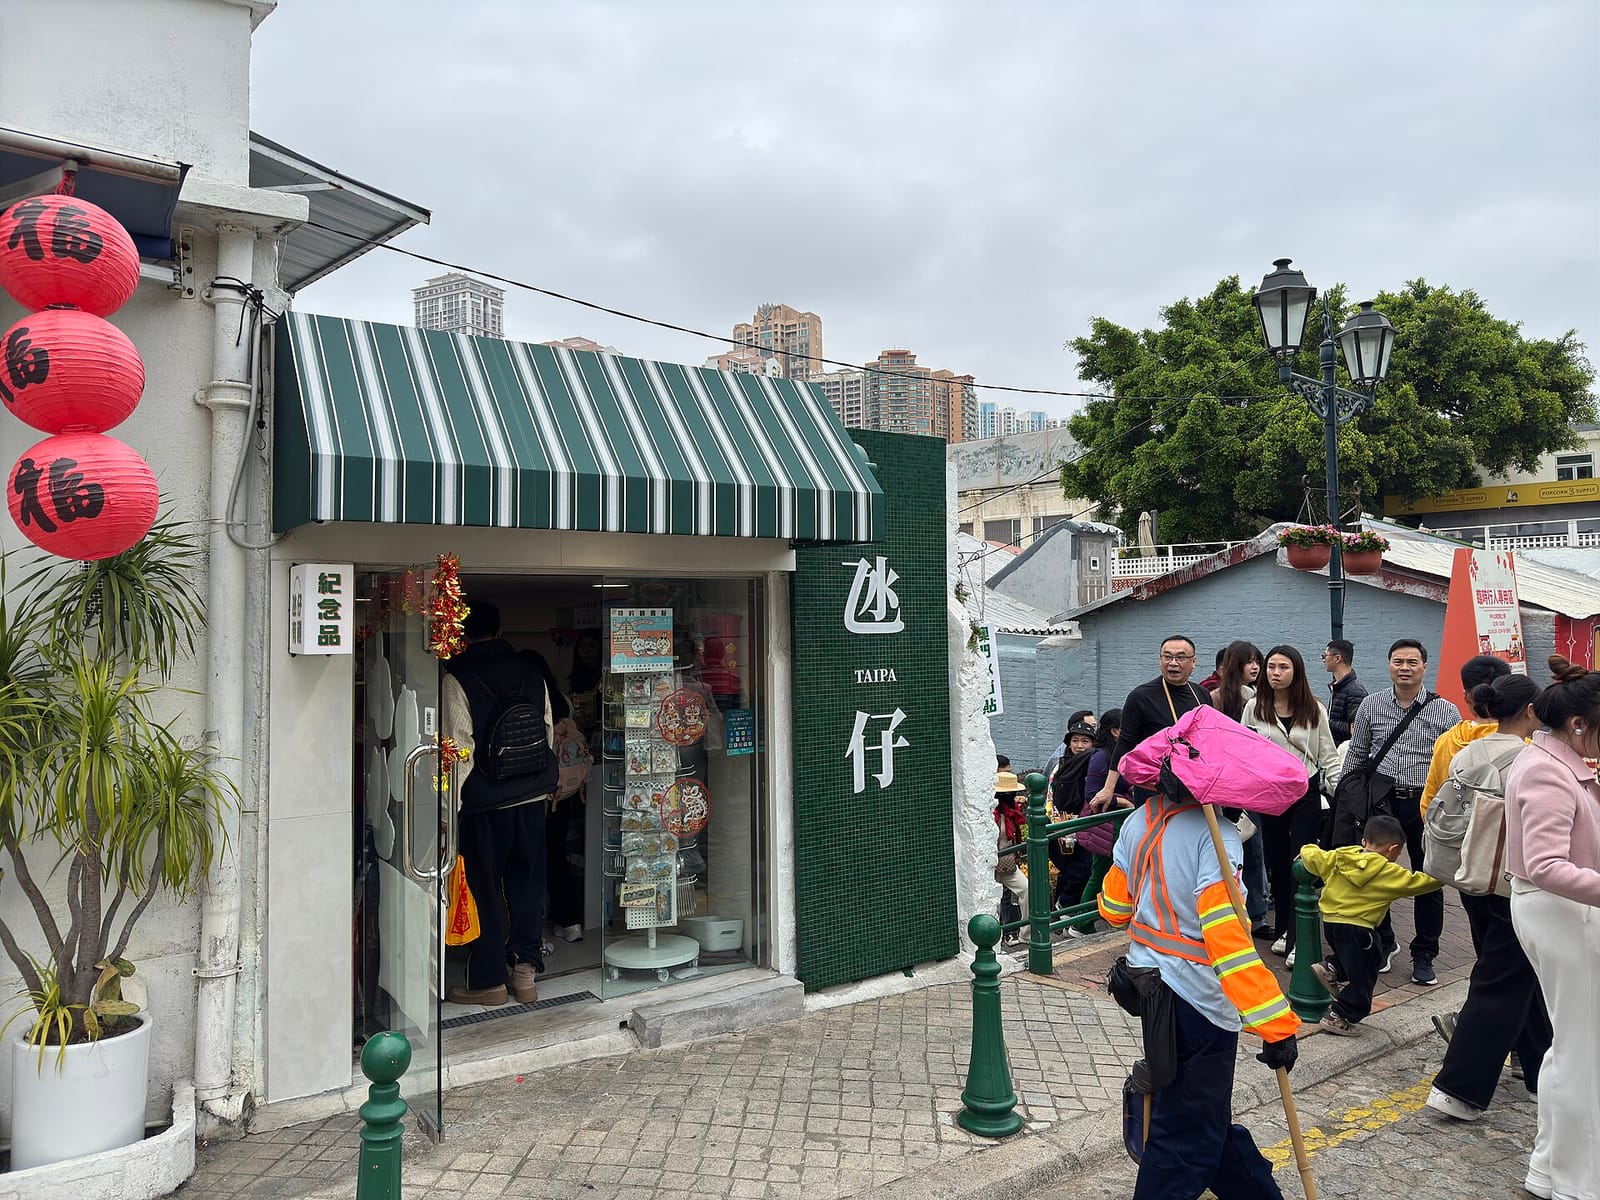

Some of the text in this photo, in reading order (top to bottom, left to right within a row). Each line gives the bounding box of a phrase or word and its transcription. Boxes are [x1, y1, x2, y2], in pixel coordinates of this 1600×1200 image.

[7, 198, 104, 264] 福
[14, 457, 106, 533] 福
[1542, 489, 1568, 497] POPCORN
[317, 572, 342, 647] 紀念品
[854, 668, 897, 684] TAIPA
[844, 707, 911, 794] 仔
